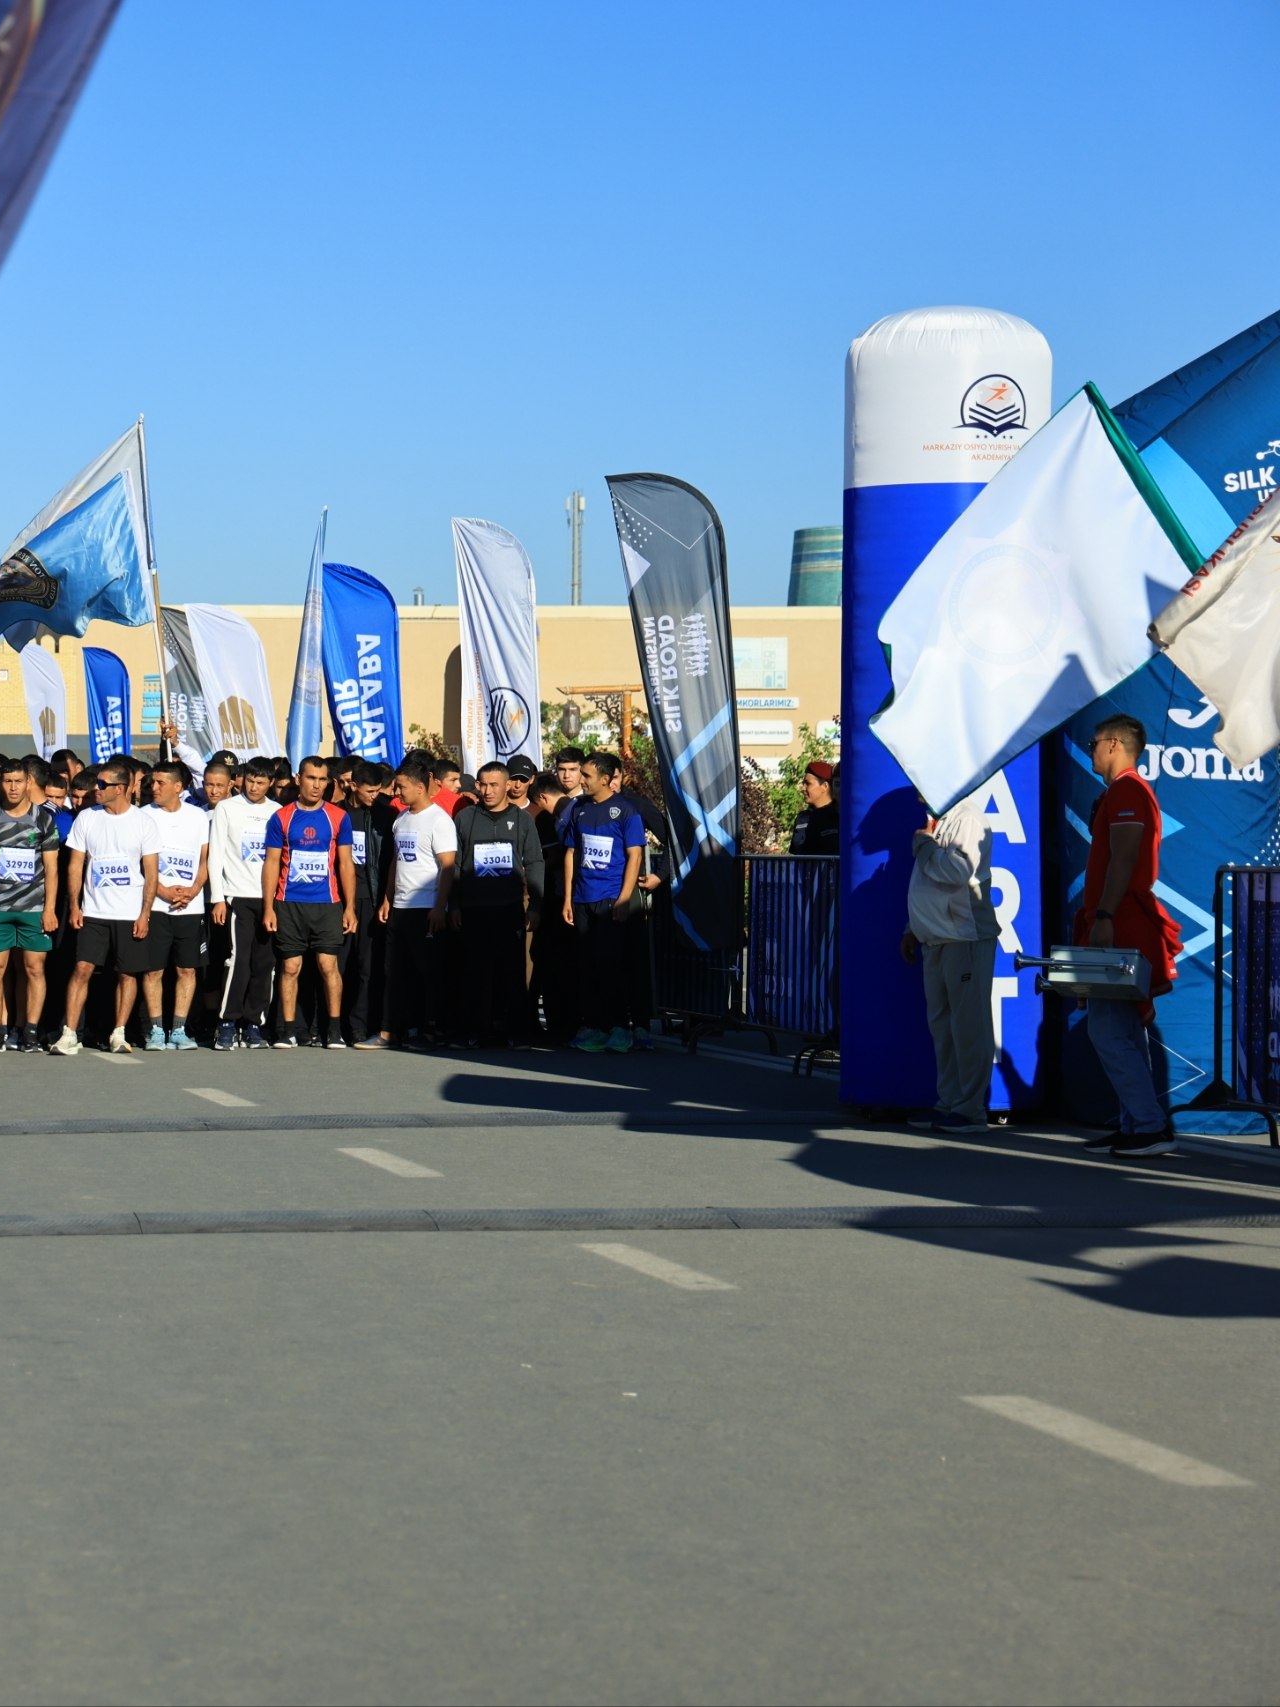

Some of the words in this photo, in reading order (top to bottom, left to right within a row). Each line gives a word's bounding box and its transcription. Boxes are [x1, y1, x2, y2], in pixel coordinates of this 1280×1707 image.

[922, 443, 961, 452] MARKAZIY
[963, 443, 988, 451] OSIYO
[989, 443, 1012, 451] YURISH
[1223, 466, 1278, 493] SILK
[736, 699, 794, 708] MKORLARIMIZ:
[583, 846, 610, 858] 32969
[5, 860, 34, 870] 32978
[167, 856, 193, 868] 32861
[483, 855, 511, 865] 33041
[99, 865, 129, 875] 32868
[298, 862, 325, 871] 33191
